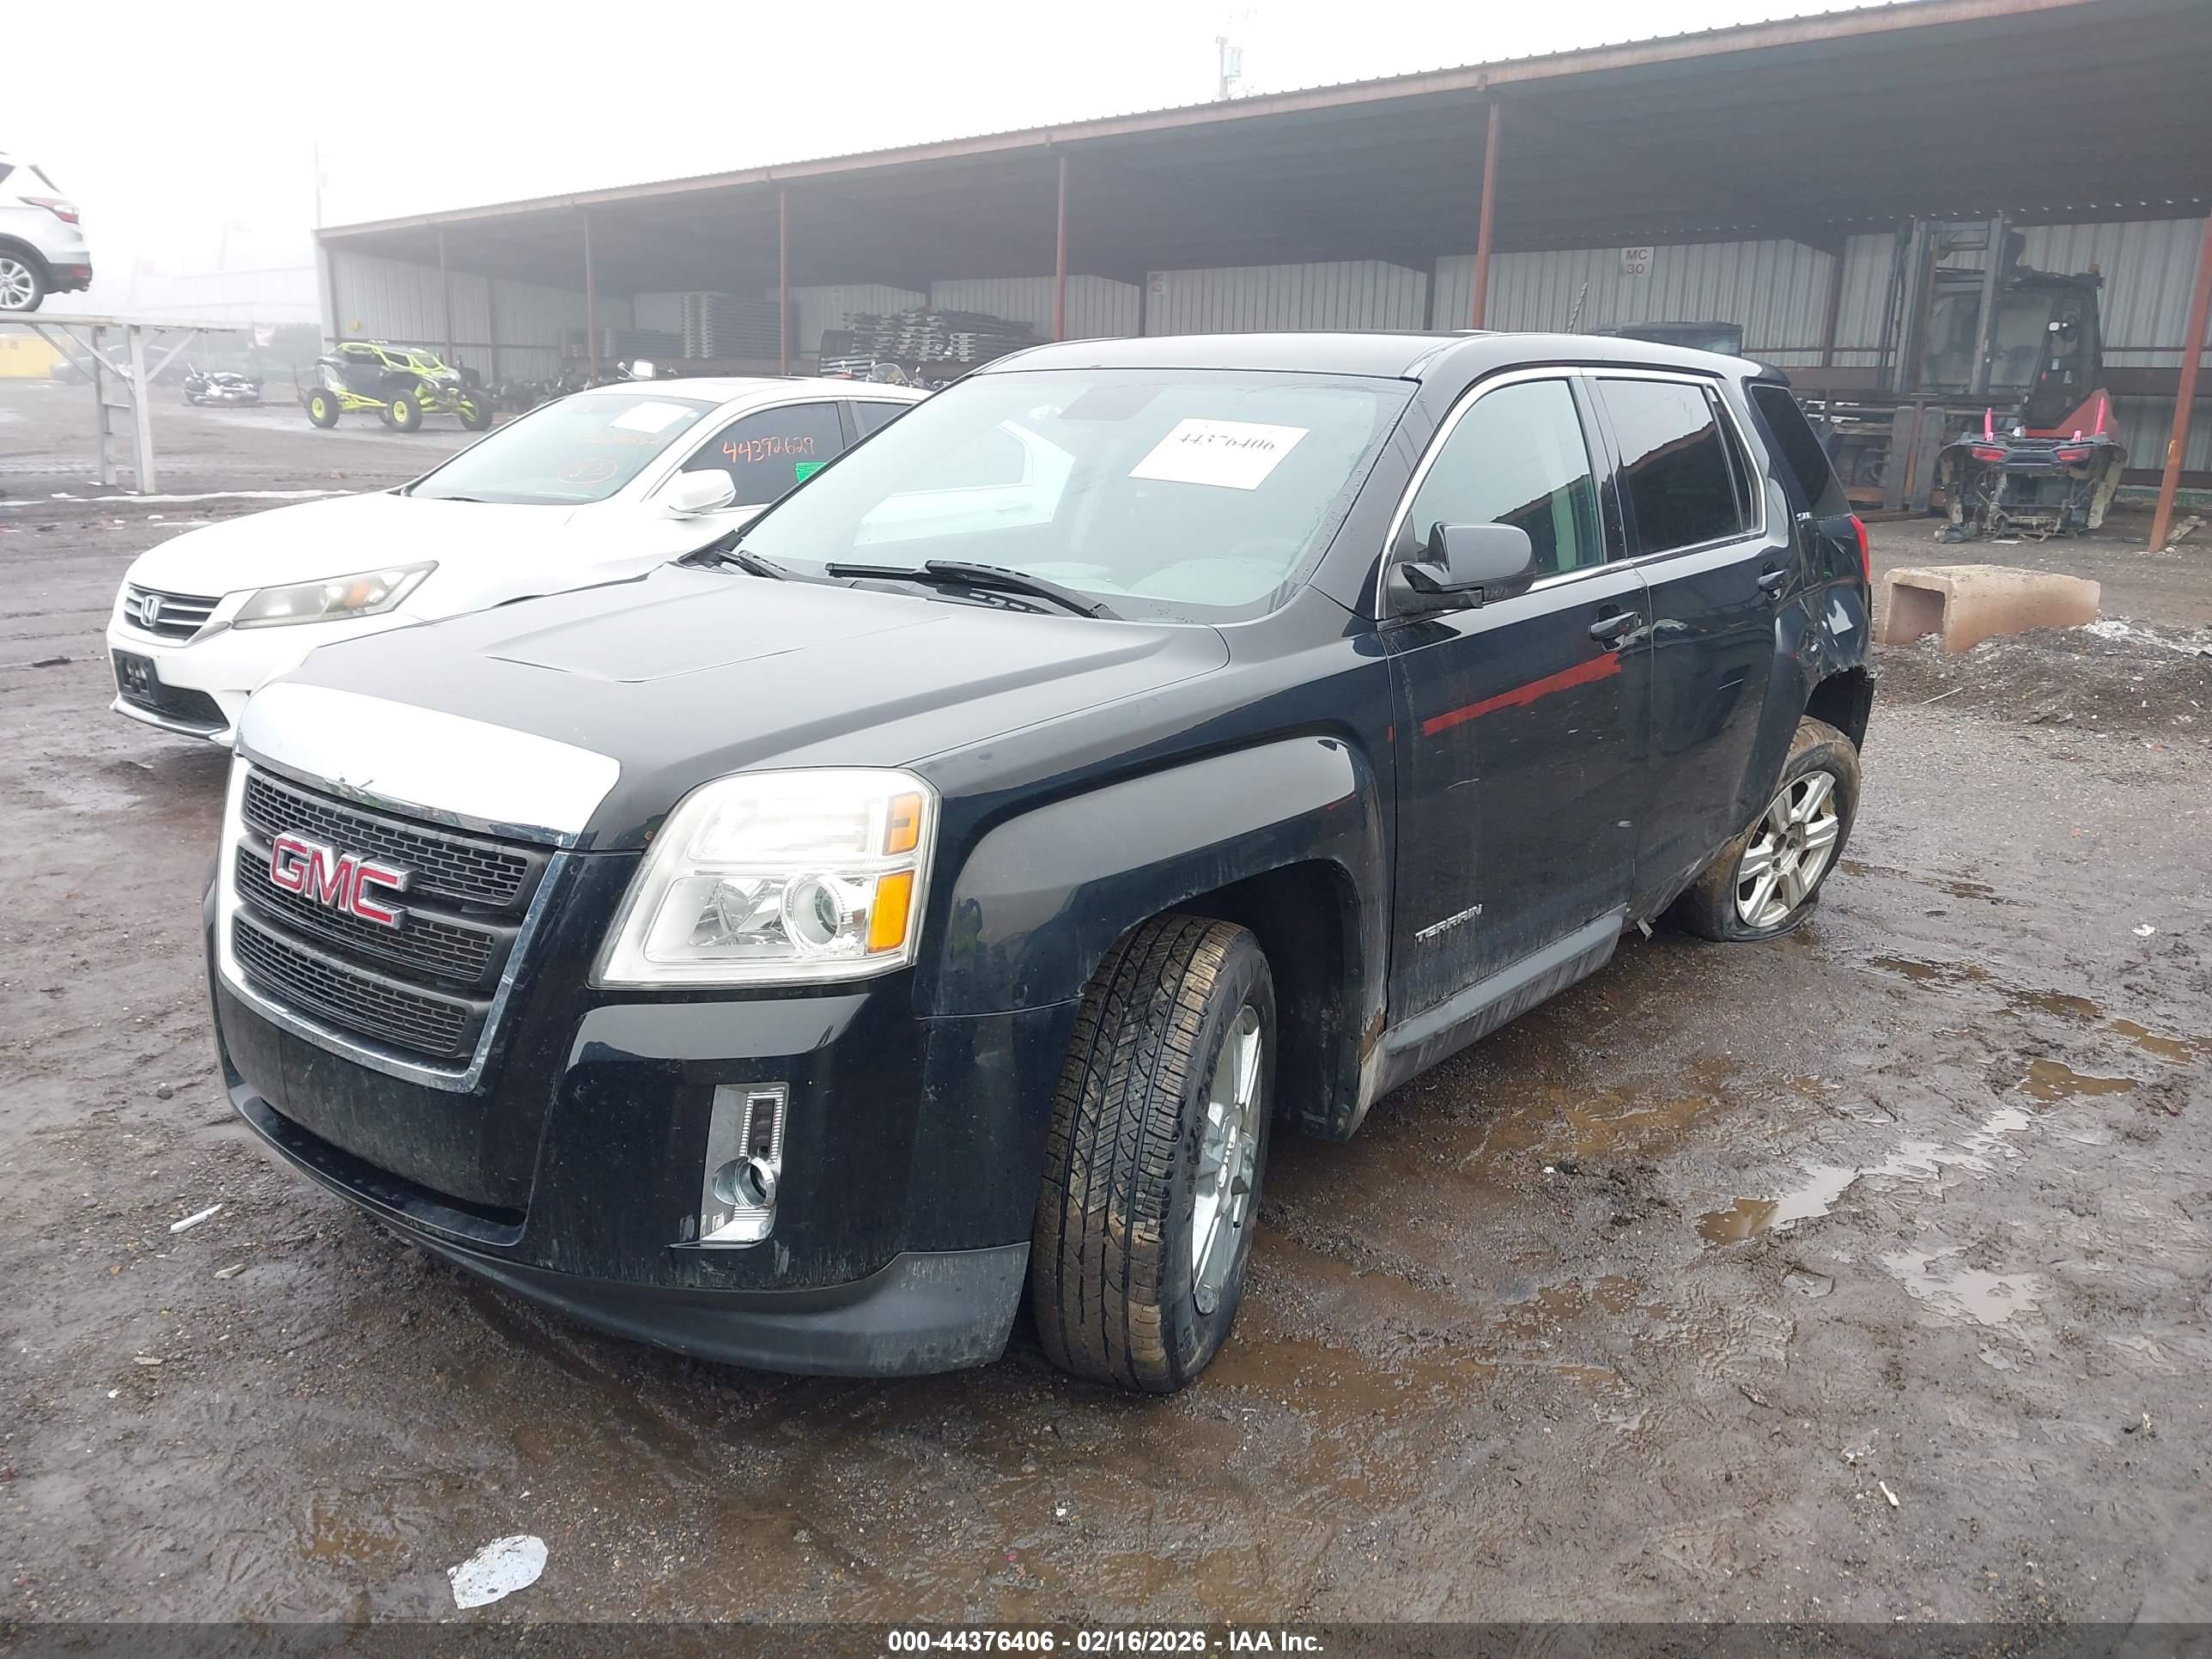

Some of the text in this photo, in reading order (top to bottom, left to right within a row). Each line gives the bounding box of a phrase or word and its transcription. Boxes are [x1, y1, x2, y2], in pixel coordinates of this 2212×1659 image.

[1626, 249, 1648, 260] MC
[1627, 264, 1644, 275] 30
[722, 436, 814, 463] 44392629
[270, 830, 416, 930] GMC
[1414, 903, 1483, 943] TERRAIN
